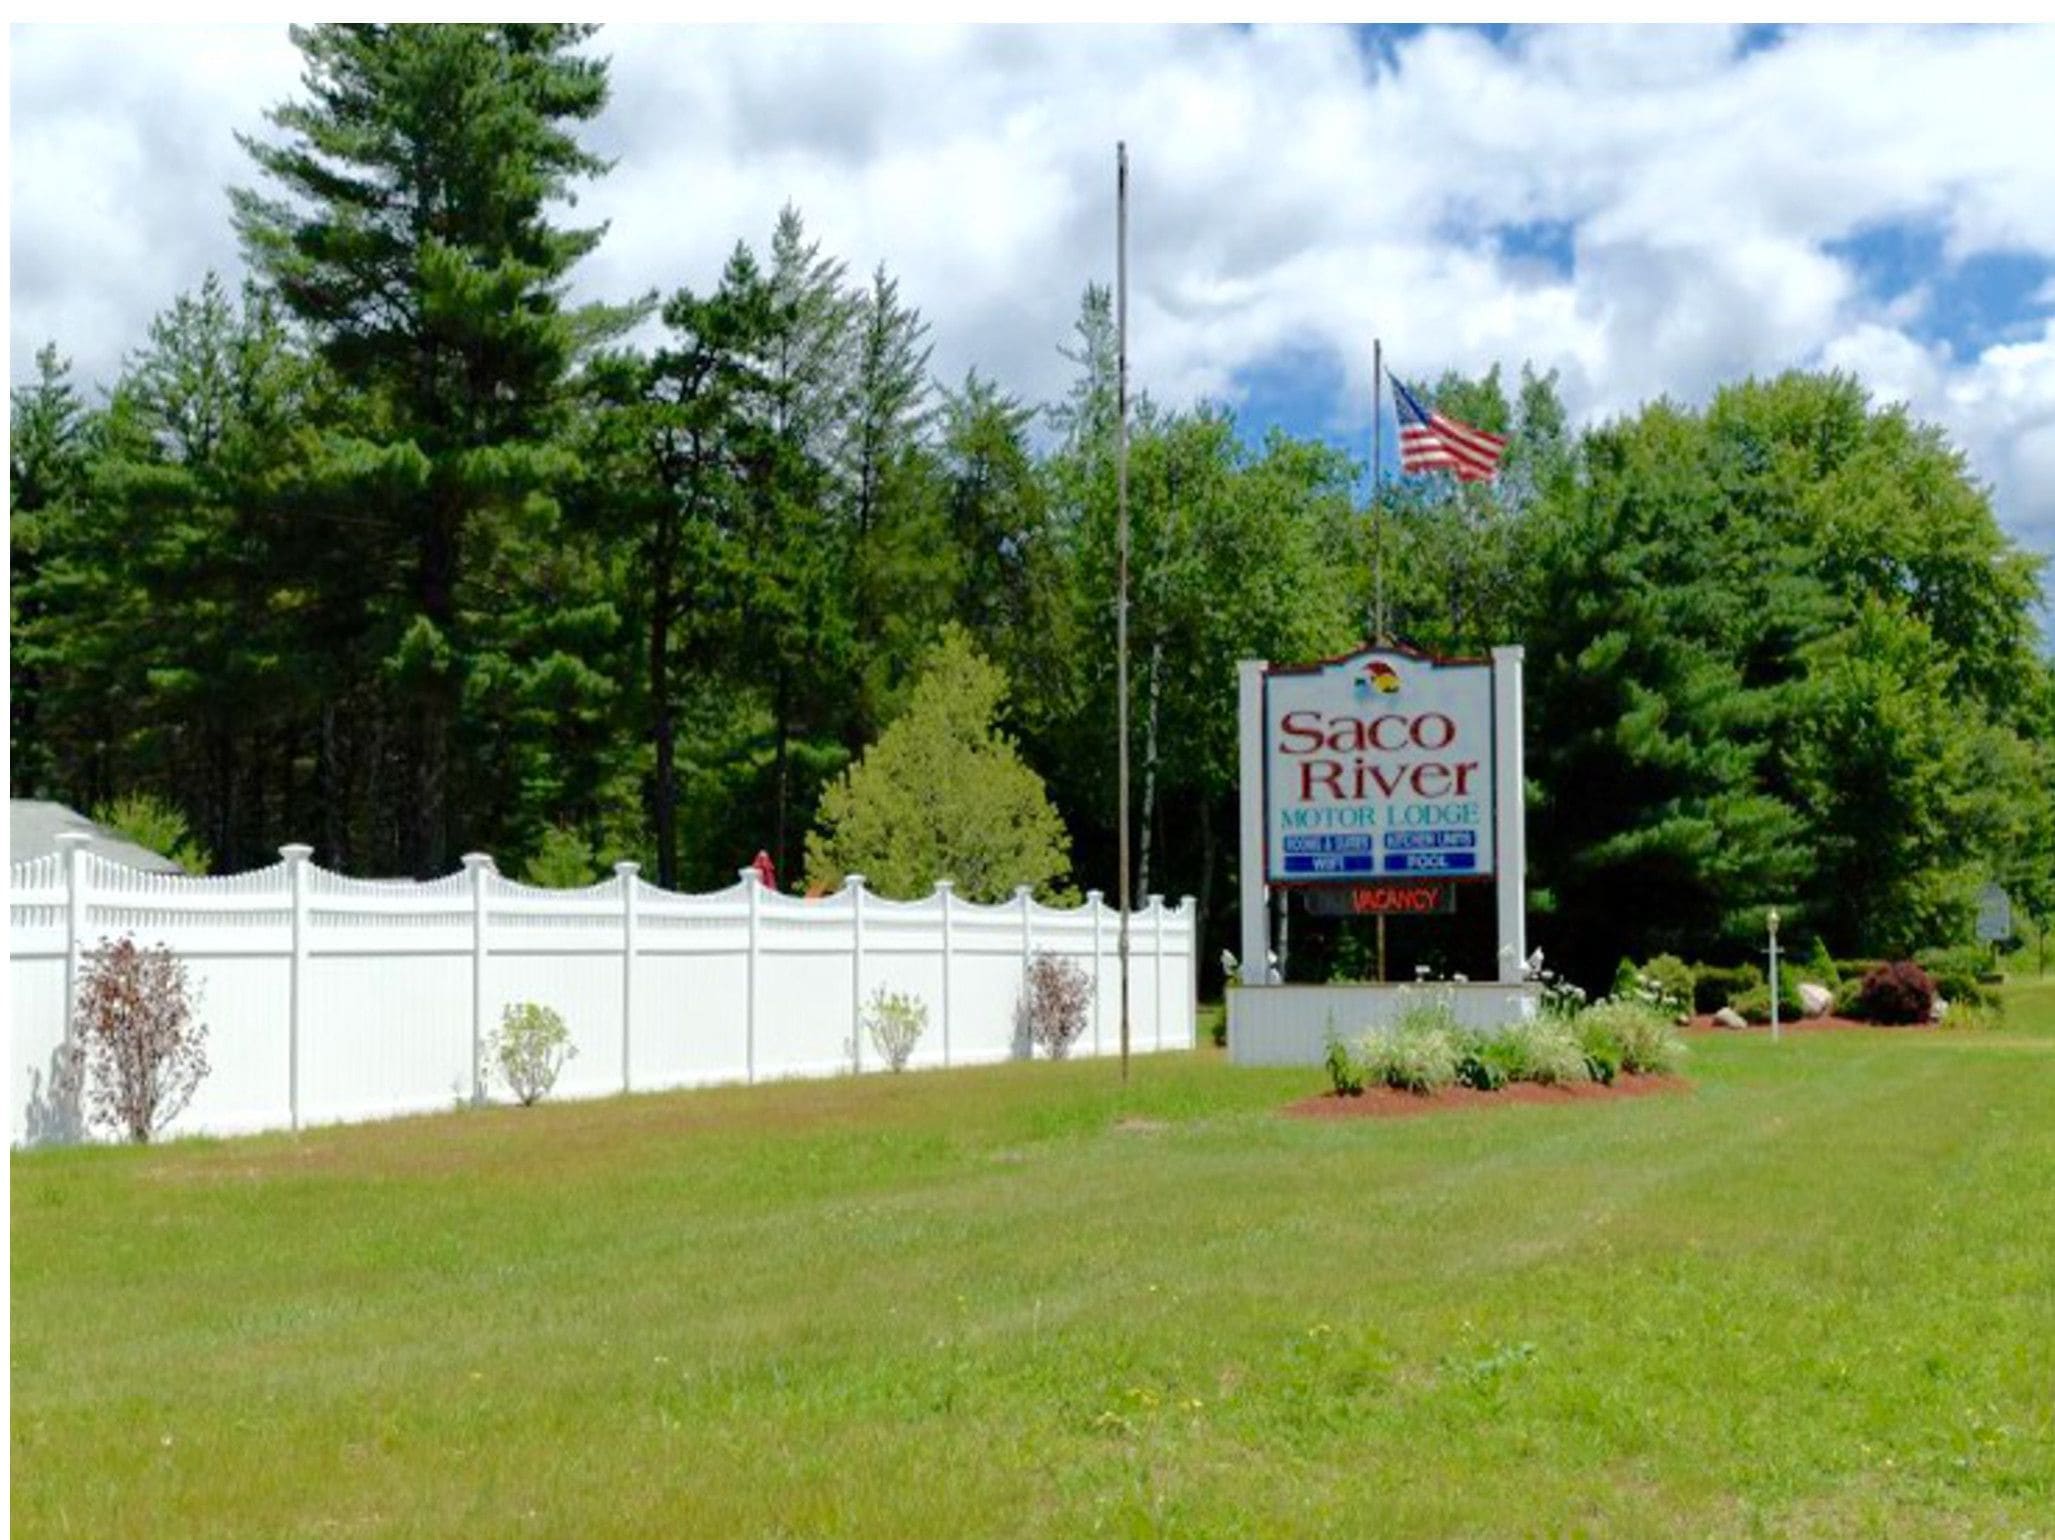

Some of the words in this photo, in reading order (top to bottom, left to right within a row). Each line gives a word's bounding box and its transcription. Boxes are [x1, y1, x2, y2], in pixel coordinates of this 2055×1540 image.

[1278, 710, 1456, 754] Saco
[1299, 757, 1479, 801] River
[1281, 806, 1376, 829] MOTOR
[1387, 802, 1480, 826] LODGE
[1353, 886, 1440, 913] VACANCY
